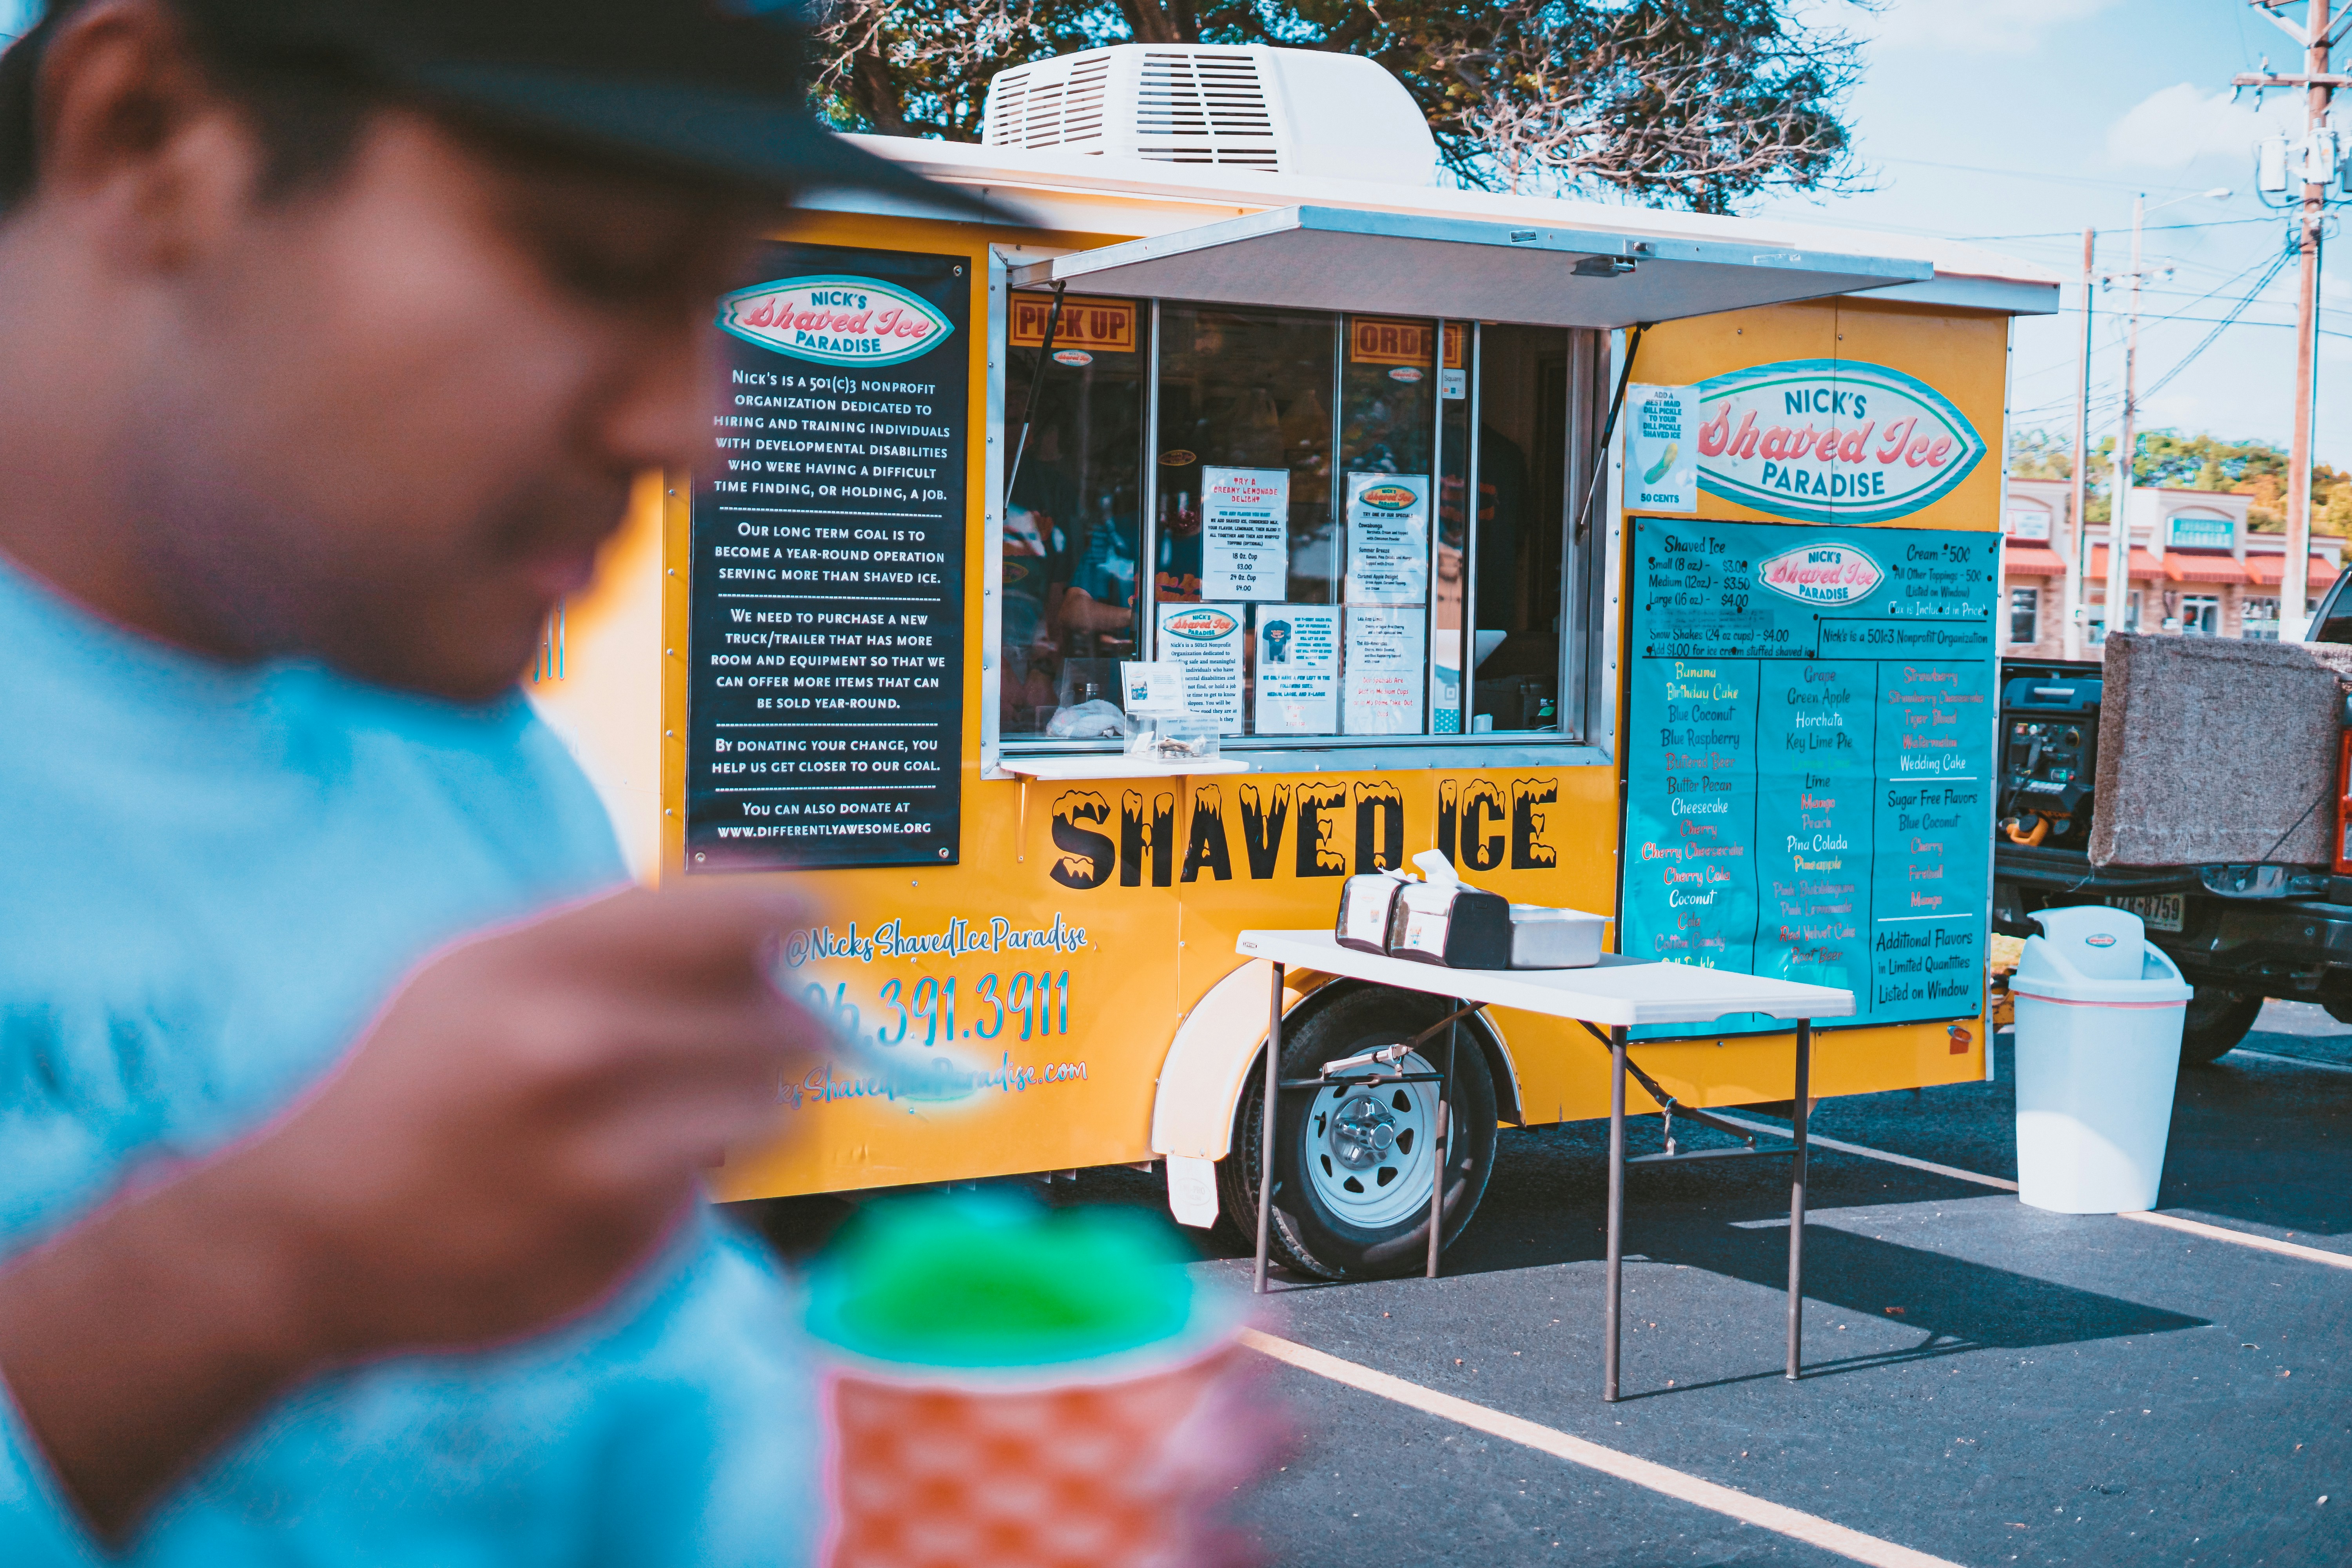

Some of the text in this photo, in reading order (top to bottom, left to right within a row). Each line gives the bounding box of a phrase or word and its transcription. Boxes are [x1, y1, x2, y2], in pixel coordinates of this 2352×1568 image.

[811, 291, 867, 309] NICK'S
[743, 297, 929, 338] Shaved Ice
[1020, 306, 1124, 339] PICK UP
[795, 331, 881, 352] PARADISE
[782, 376, 793, 386] IS
[798, 377, 806, 386] A
[862, 381, 935, 394] NONPROFIT
[735, 395, 931, 415] ORGANIZATION DEDICATED TO
[1785, 389, 1866, 419] NICK'S
[714, 416, 949, 437] HIRING AND TRAINING INDIVIDUALS
[1643, 430, 1669, 438] SHAVED
[1698, 399, 1951, 468] Shaved Ice
[716, 437, 947, 458] WITH DEVELOPMENTAL DISABILITIES
[729, 460, 936, 478] WHO WERE HAVING A DIFFICULT
[1760, 462, 1885, 497] PARADISE
[714, 481, 946, 501] TIME FINDING, OR HOLDING, A JOB.
[1641, 493, 1679, 503] 50 CENTS
[1664, 535, 1725, 554] Shaved Ice
[1648, 557, 1672, 570] Small
[1675, 558, 1685, 571] (8
[1723, 560, 1748, 573] $3.00
[1809, 551, 1841, 564] NICK'S
[1649, 574, 1682, 587] Medium
[1724, 577, 1750, 590] $3.50
[1769, 559, 1875, 585] Shaved Ice
[1650, 592, 1672, 608] Large
[1675, 592, 1687, 605] (16
[1721, 593, 1748, 607] $4.00
[1800, 584, 1848, 599] PARADISE
[1172, 619, 1230, 629] Shaved Ice
[1675, 662, 1716, 679] Banana
[1804, 666, 1836, 686] Grape
[1788, 688, 1851, 708] Green Apple
[1668, 704, 1736, 723] Blue Coconut
[1796, 711, 1842, 728] Horchata
[1661, 728, 1740, 750] Blue Raspberry
[1786, 732, 1851, 753] Key Lime Pie
[1665, 751, 1735, 771] Buttered Beer
[1901, 754, 1965, 774] Wedding Cake
[1666, 775, 1731, 795] Butter Pecan
[1806, 773, 1830, 789] Lime
[743, 802, 910, 815] YOU CAN ALSO DONATE AT
[1672, 798, 1728, 815] Cheesecake
[1888, 789, 1977, 810] Sugar Free Flavors
[718, 823, 931, 837] WWW.DIFFERENTLYAWESOME.ORG
[1050, 778, 1557, 889] SHAVED ICE
[1680, 819, 1717, 840] Cherry
[1813, 834, 1847, 852] Colada
[1664, 865, 1731, 887] Cherry Cola
[1670, 889, 1717, 907] Coconut
[1678, 911, 1700, 930] Cola
[786, 911, 1088, 970] @NicksShavedIceParadise
[1876, 929, 1972, 952] Additional Flavors
[1878, 955, 1970, 975] in Limited Quantities
[1879, 981, 1969, 1004] Listed on Window
